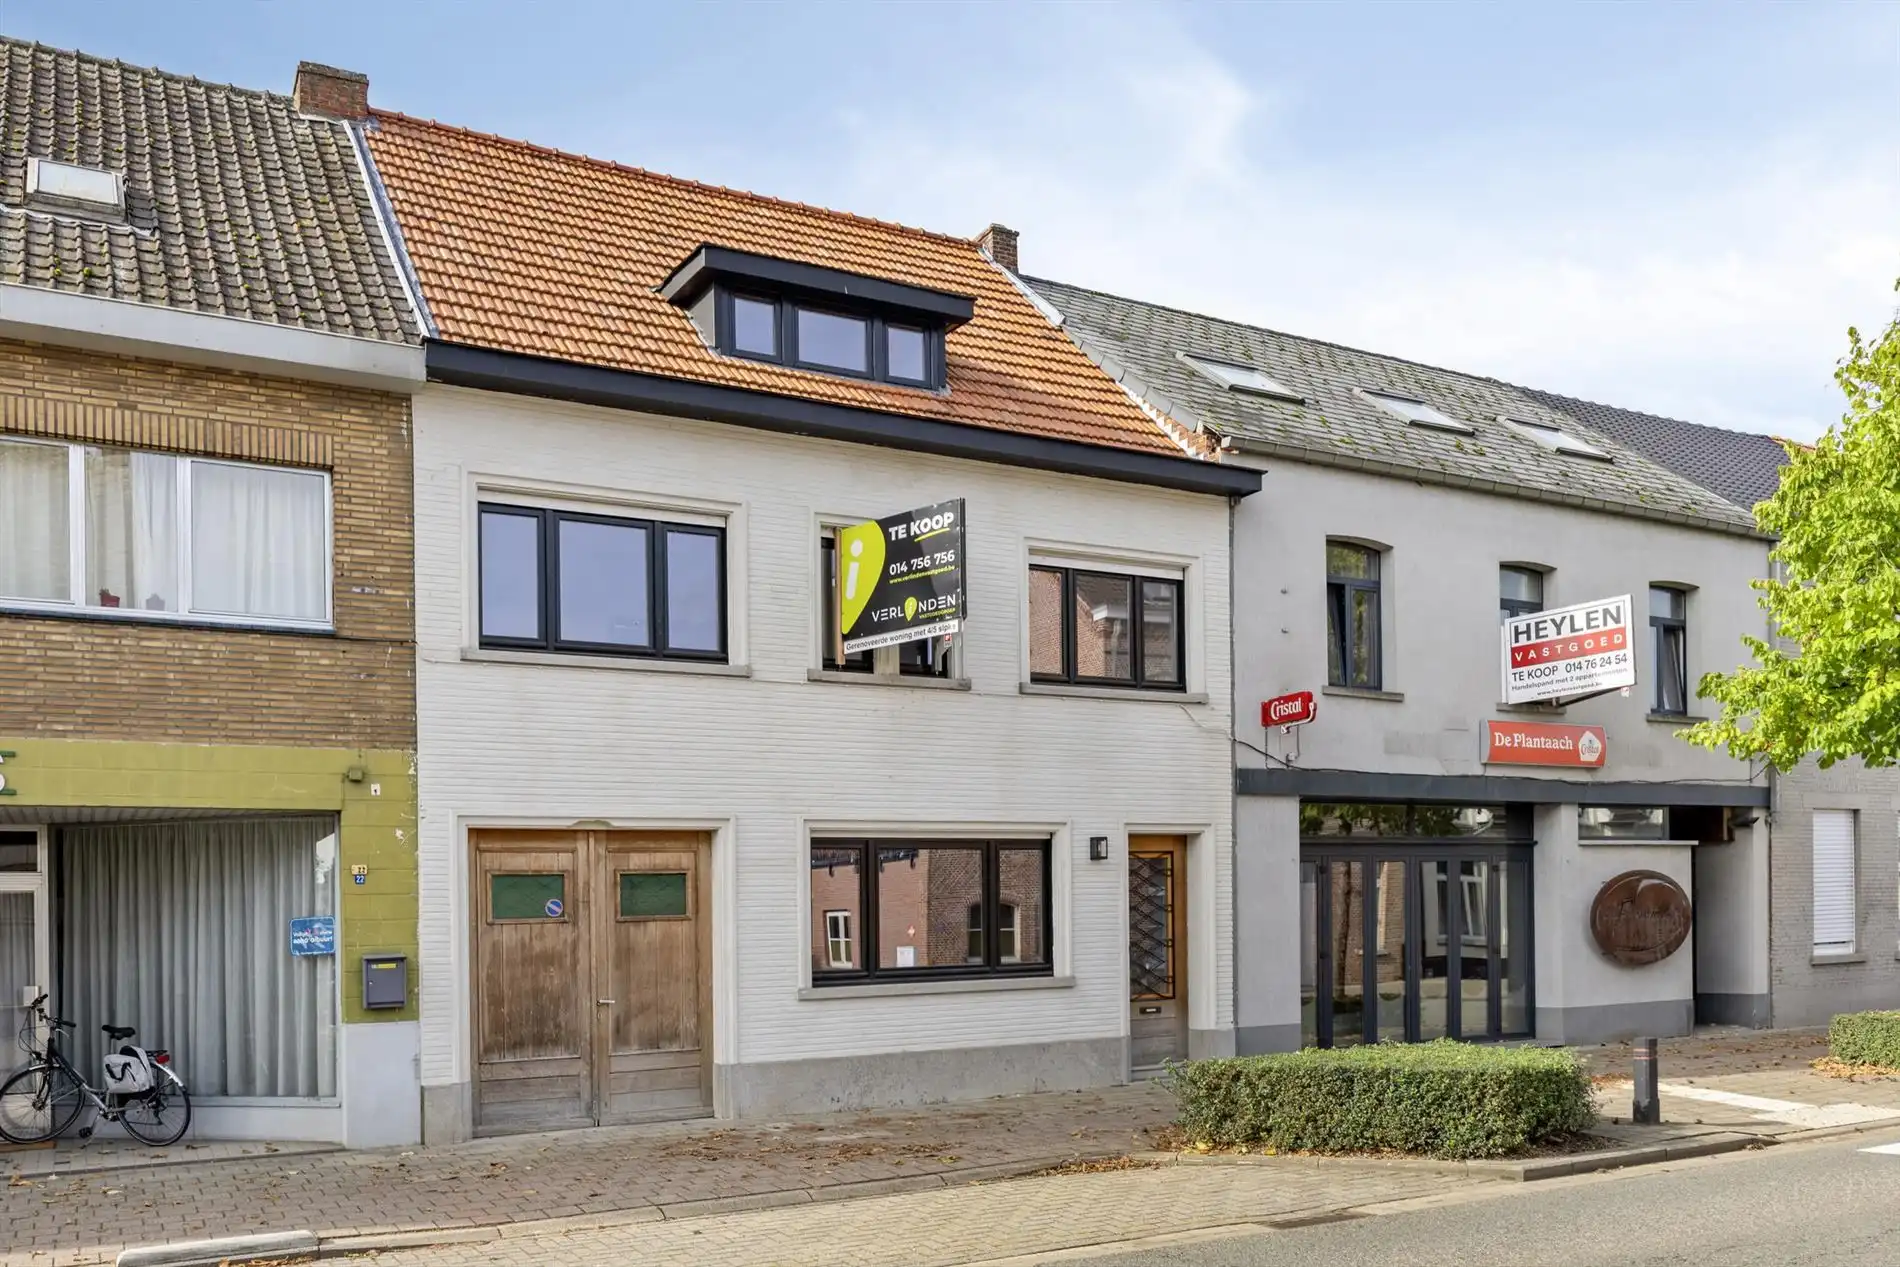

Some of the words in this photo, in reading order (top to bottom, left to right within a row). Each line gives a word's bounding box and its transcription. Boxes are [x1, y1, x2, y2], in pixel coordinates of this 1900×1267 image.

[889, 525, 906, 541] TE
[911, 512, 954, 536] KOOP
[889, 561, 908, 575] 014
[911, 555, 931, 570] 756
[934, 549, 955, 565] 756
[1514, 605, 1622, 643] HEYLEN
[846, 636, 889, 651] Gerenoveerde
[889, 631, 912, 643] woning
[913, 629, 926, 637] met
[1514, 634, 1623, 662] VASTGOED
[1512, 671, 1524, 682] TE
[1527, 665, 1558, 679] KOOP
[1565, 661, 1583, 673] 014
[1585, 659, 1597, 670] 76
[1600, 656, 1612, 668] 24
[1615, 653, 1627, 665] 54
[1512, 679, 1554, 691] Handelspand
[1271, 697, 1302, 720] Cristal
[1494, 732, 1511, 747] De
[1513, 733, 1573, 750] Plantaach
[356, 875, 365, 883] 22
